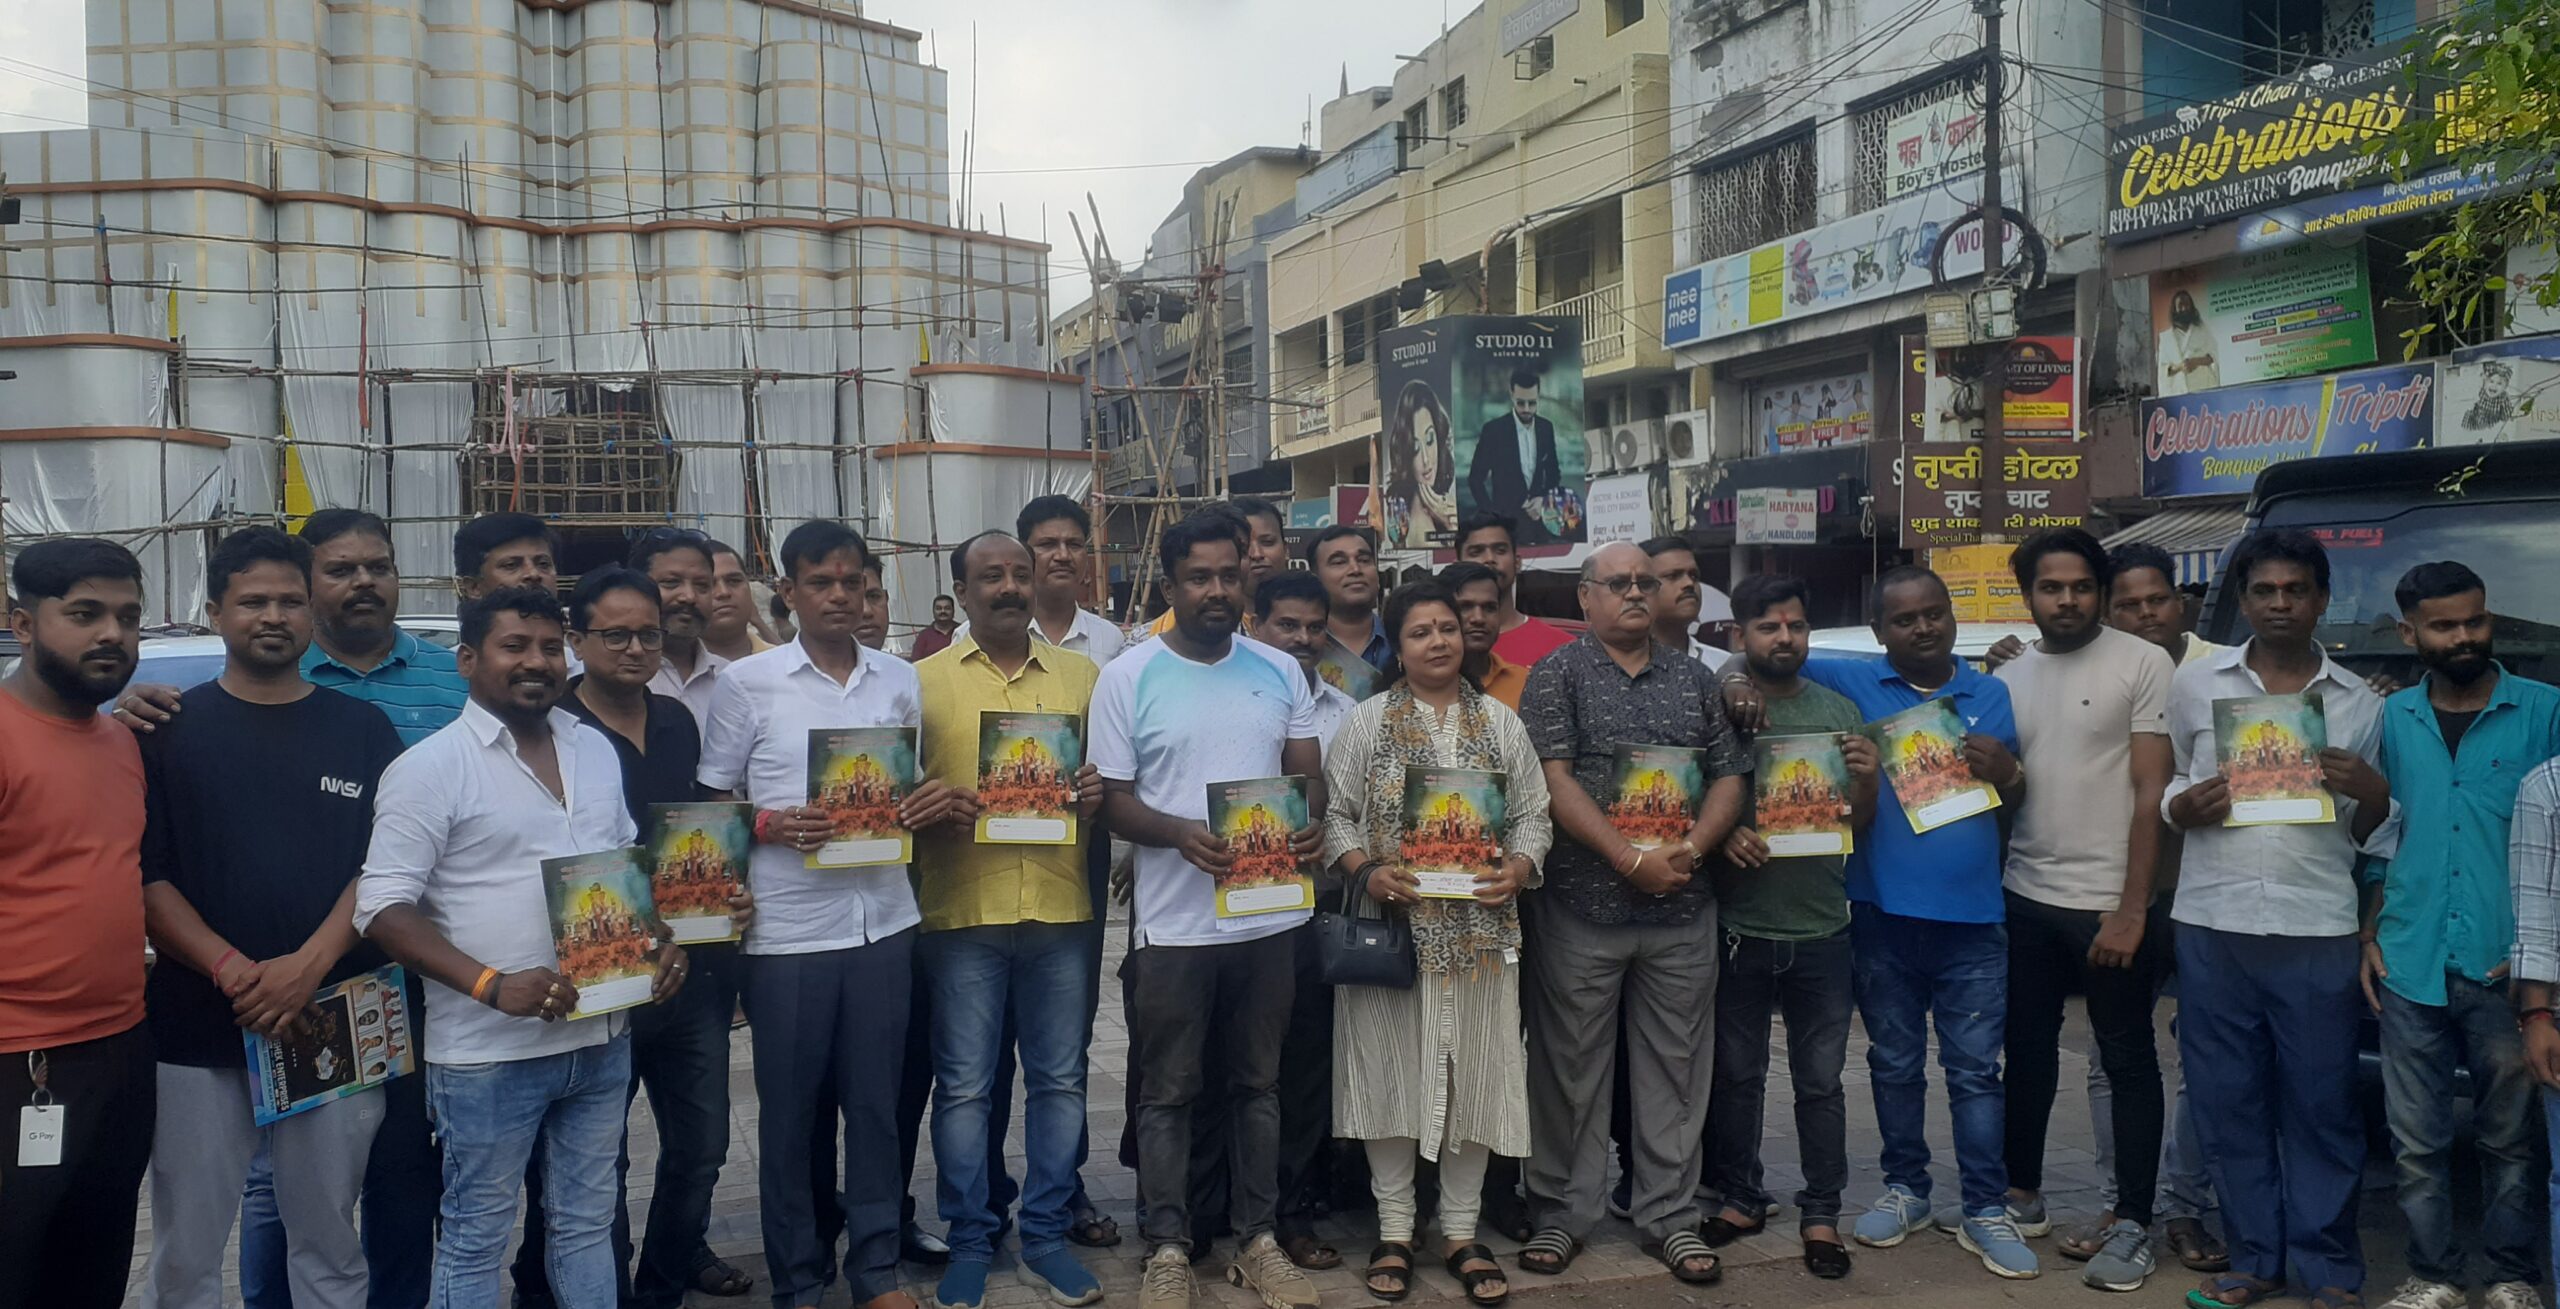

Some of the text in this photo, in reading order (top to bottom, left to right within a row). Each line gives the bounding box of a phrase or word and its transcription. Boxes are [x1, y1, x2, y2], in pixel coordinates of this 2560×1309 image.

[2201, 91, 2250, 123] Tripti
[2110, 116, 2203, 156] ANNIVERSARY
[2120, 82, 2414, 209] Celebrations
[1896, 135, 1923, 169] महा
[1896, 167, 1936, 193] Boy's
[2109, 197, 2178, 223] BIRTHDAY
[2203, 186, 2281, 218] MARRIAGE
[1955, 221, 2013, 256] WOD
[1668, 287, 1698, 310] mee
[1668, 307, 1697, 330] mee
[1392, 340, 1437, 362] STUDIO 11
[1475, 334, 1554, 349] STUDIO 11
[2024, 364, 2038, 374] OF
[2038, 363, 2073, 375] LIVING
[2336, 374, 2433, 434] Tripti
[1817, 428, 1835, 438] FREE
[2145, 400, 2318, 462] Celebrations
[2004, 447, 2082, 483] होटल
[1769, 501, 1815, 513] HARYANA
[2007, 490, 2051, 509] चाट
[2028, 513, 2082, 528] भोजन
[1768, 530, 1815, 541] HANDLOOM
[1930, 533, 1962, 544] Special
[276, 1062, 291, 1112] ENTERPRISES
[39, 1132, 55, 1141] Pay
